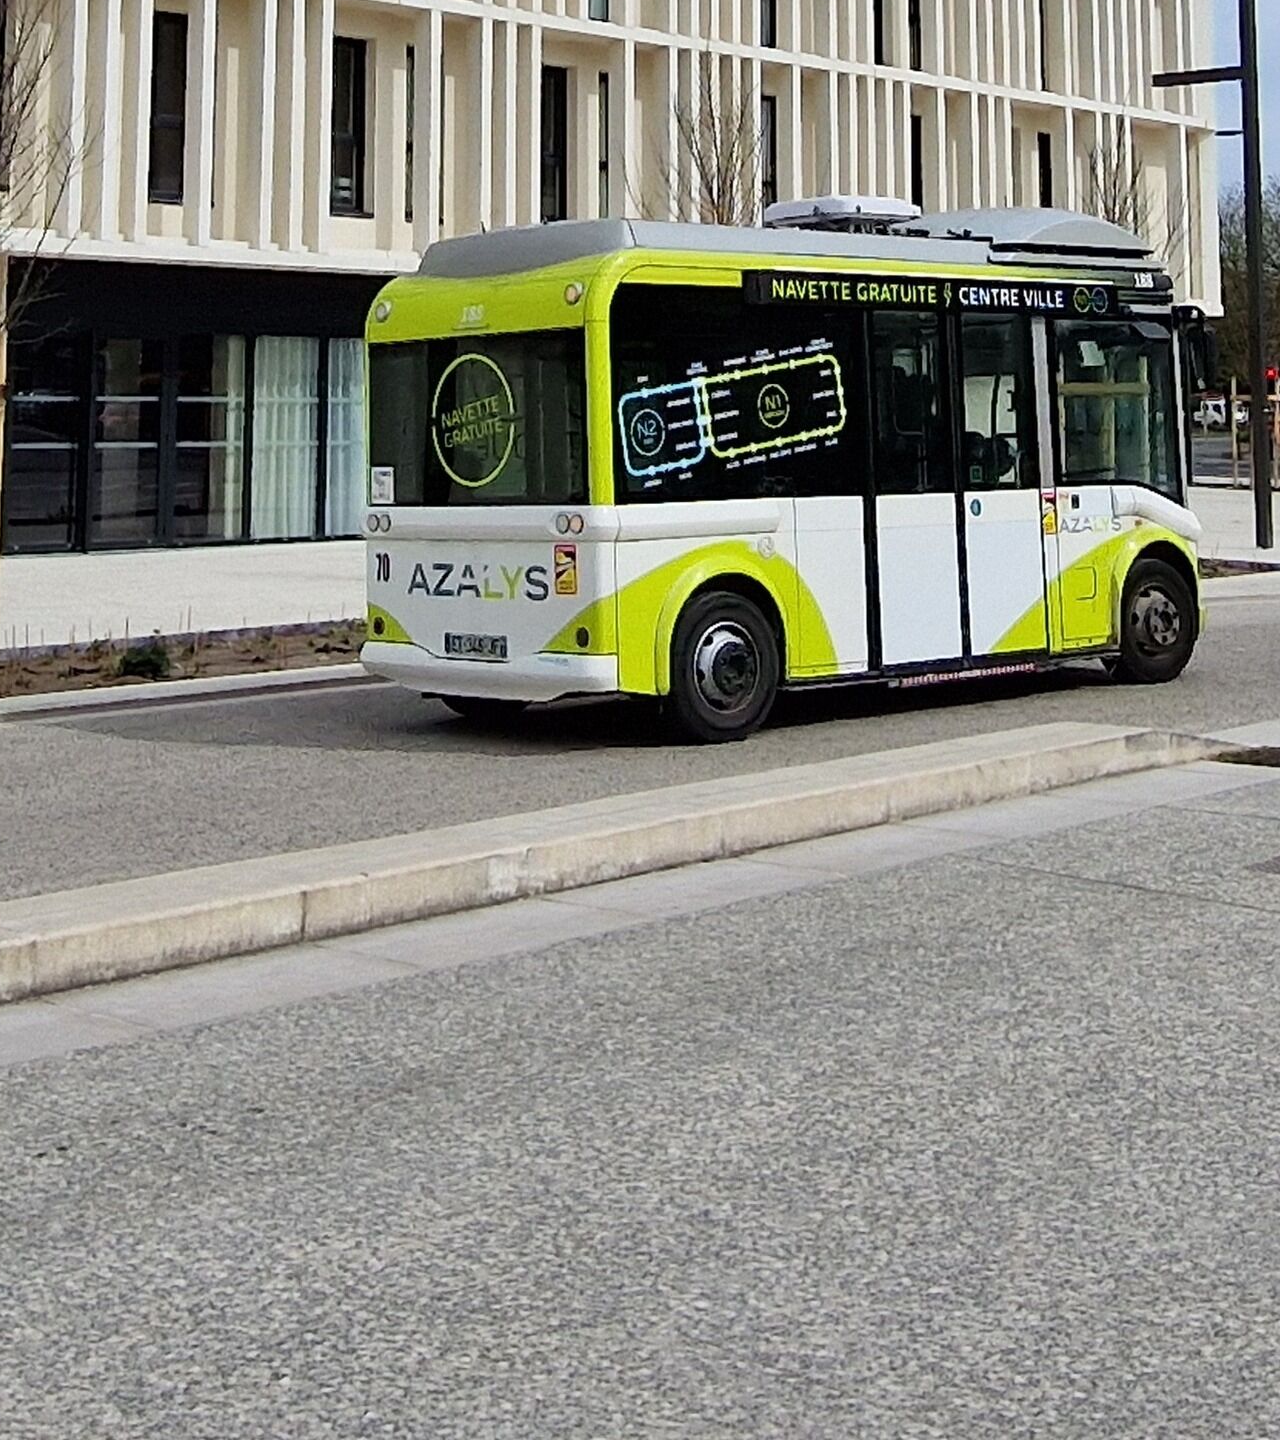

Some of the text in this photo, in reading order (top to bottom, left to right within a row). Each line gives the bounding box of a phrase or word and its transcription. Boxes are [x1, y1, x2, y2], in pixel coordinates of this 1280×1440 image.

[771, 278, 851, 301] NAVETTE
[856, 282, 937, 304] GRATUITE
[958, 286, 1020, 307] CENTRE
[1023, 289, 1064, 308] VILLE
[441, 397, 500, 428] NAVETTE
[765, 395, 781, 410] N1
[444, 419, 503, 448] GRATUITE
[637, 420, 658, 439] N2
[1059, 517, 1121, 533] AZALYS
[407, 563, 549, 601] AZALYS
